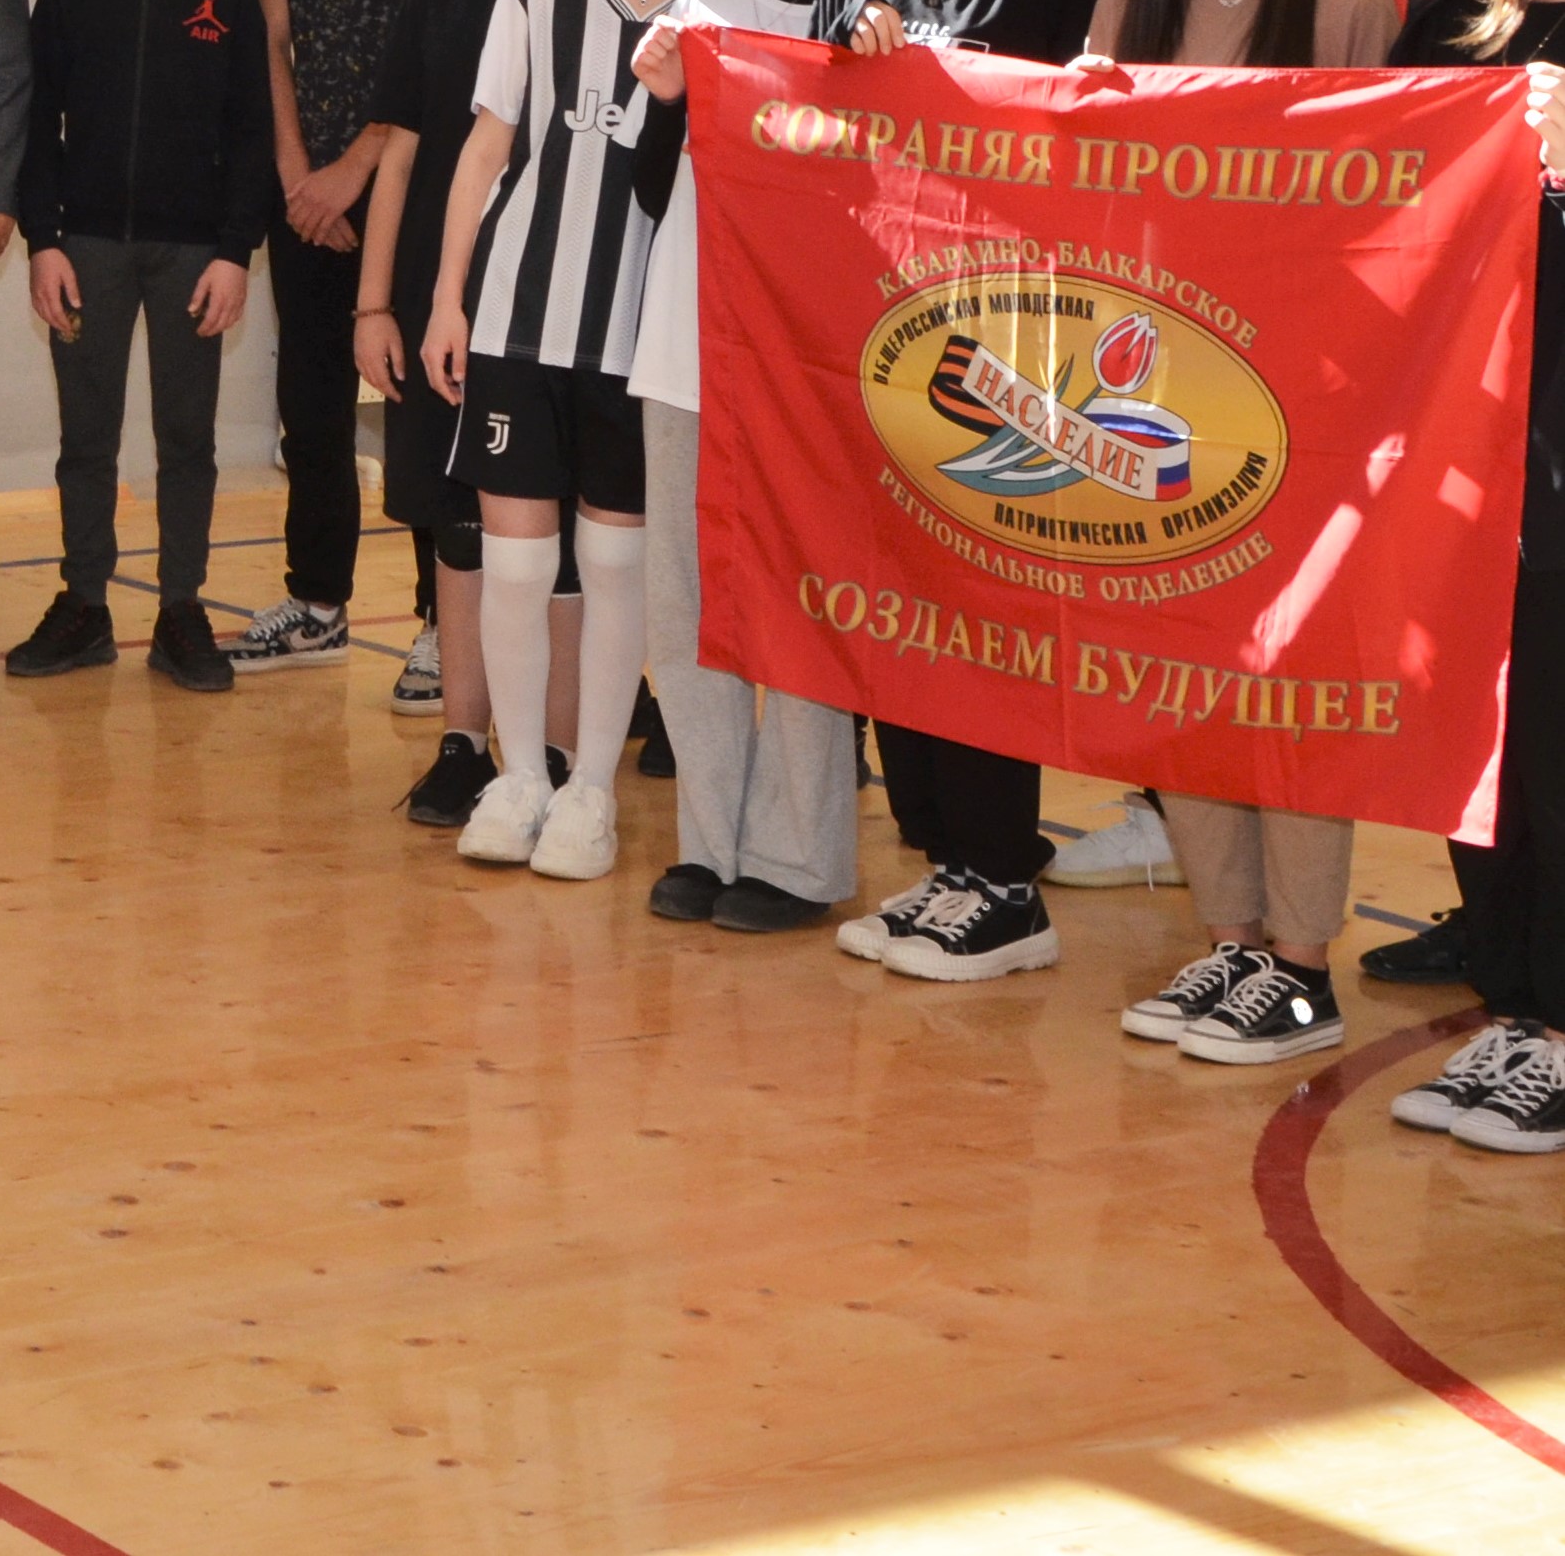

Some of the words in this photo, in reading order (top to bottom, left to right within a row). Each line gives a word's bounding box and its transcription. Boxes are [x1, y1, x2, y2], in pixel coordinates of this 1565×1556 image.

[749, 99, 1054, 188] СОХРАНЯЯ
[1071, 137, 1428, 210] ПРОШЛОЕ
[974, 358, 1146, 492] НАСЛЕДИЕ
[876, 464, 1087, 599] РЕГИОНАЛЬНОЕ
[1098, 530, 1274, 606] ОТДЕЛЕНИЕ
[993, 502, 1147, 546] ПАТРИОТИЧЕСКАЯ
[1160, 450, 1269, 541] ОРГАНИЗАЦИЯ
[796, 571, 1058, 685] СОЗДАЕМ
[1072, 638, 1402, 743] БУДУЩЕЕ
